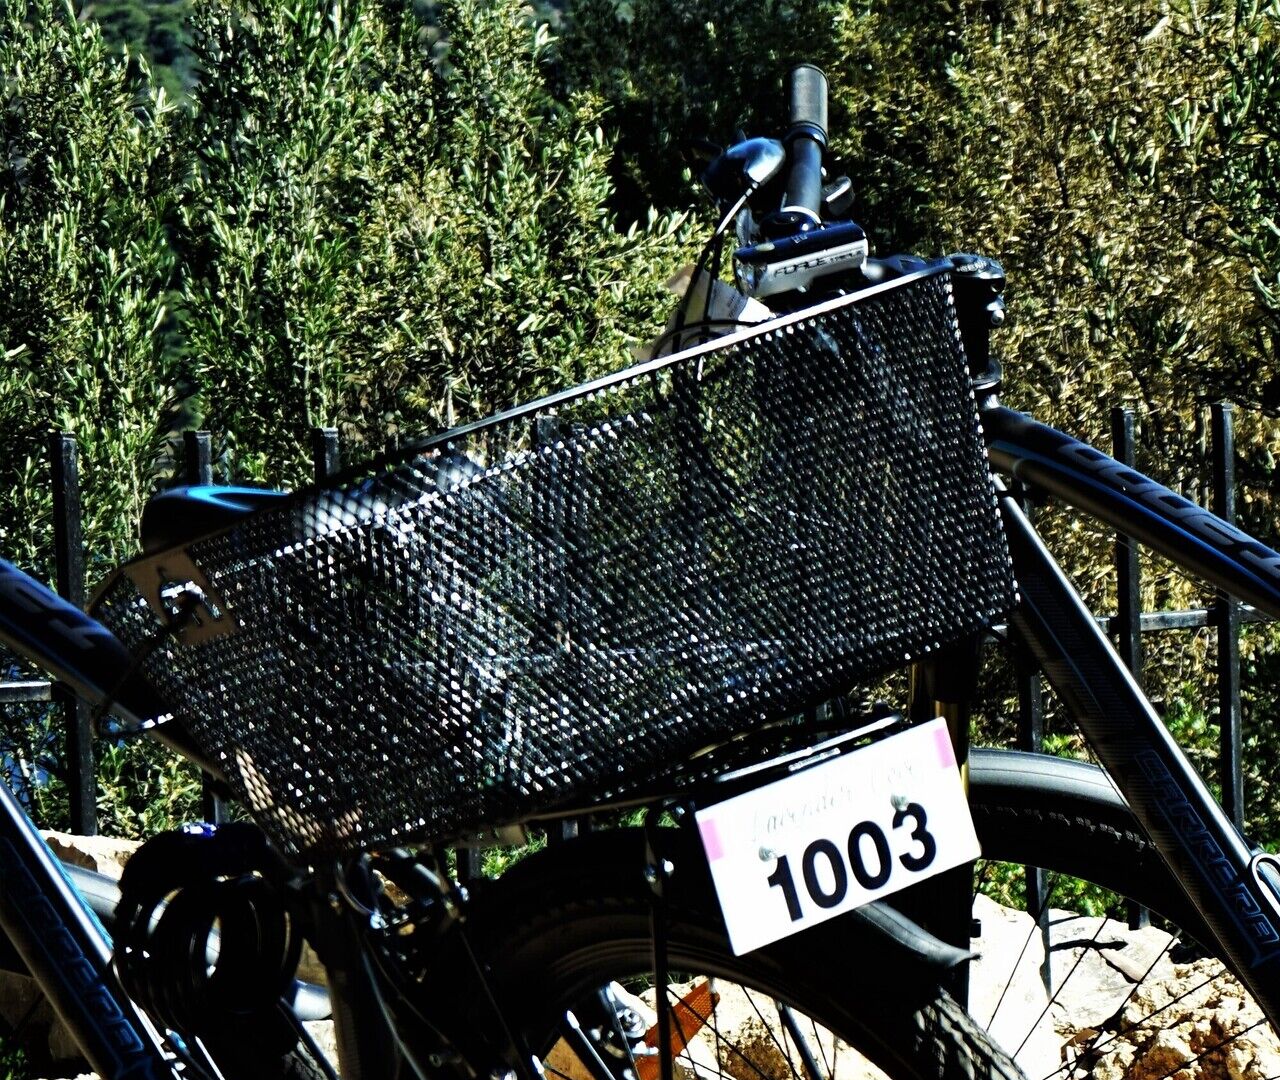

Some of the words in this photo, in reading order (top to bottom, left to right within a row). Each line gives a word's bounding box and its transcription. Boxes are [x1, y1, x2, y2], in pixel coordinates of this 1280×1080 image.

[774, 257, 829, 278] FORCE
[767, 802, 937, 922] 1003
[1134, 749, 1280, 943] CARRERA
